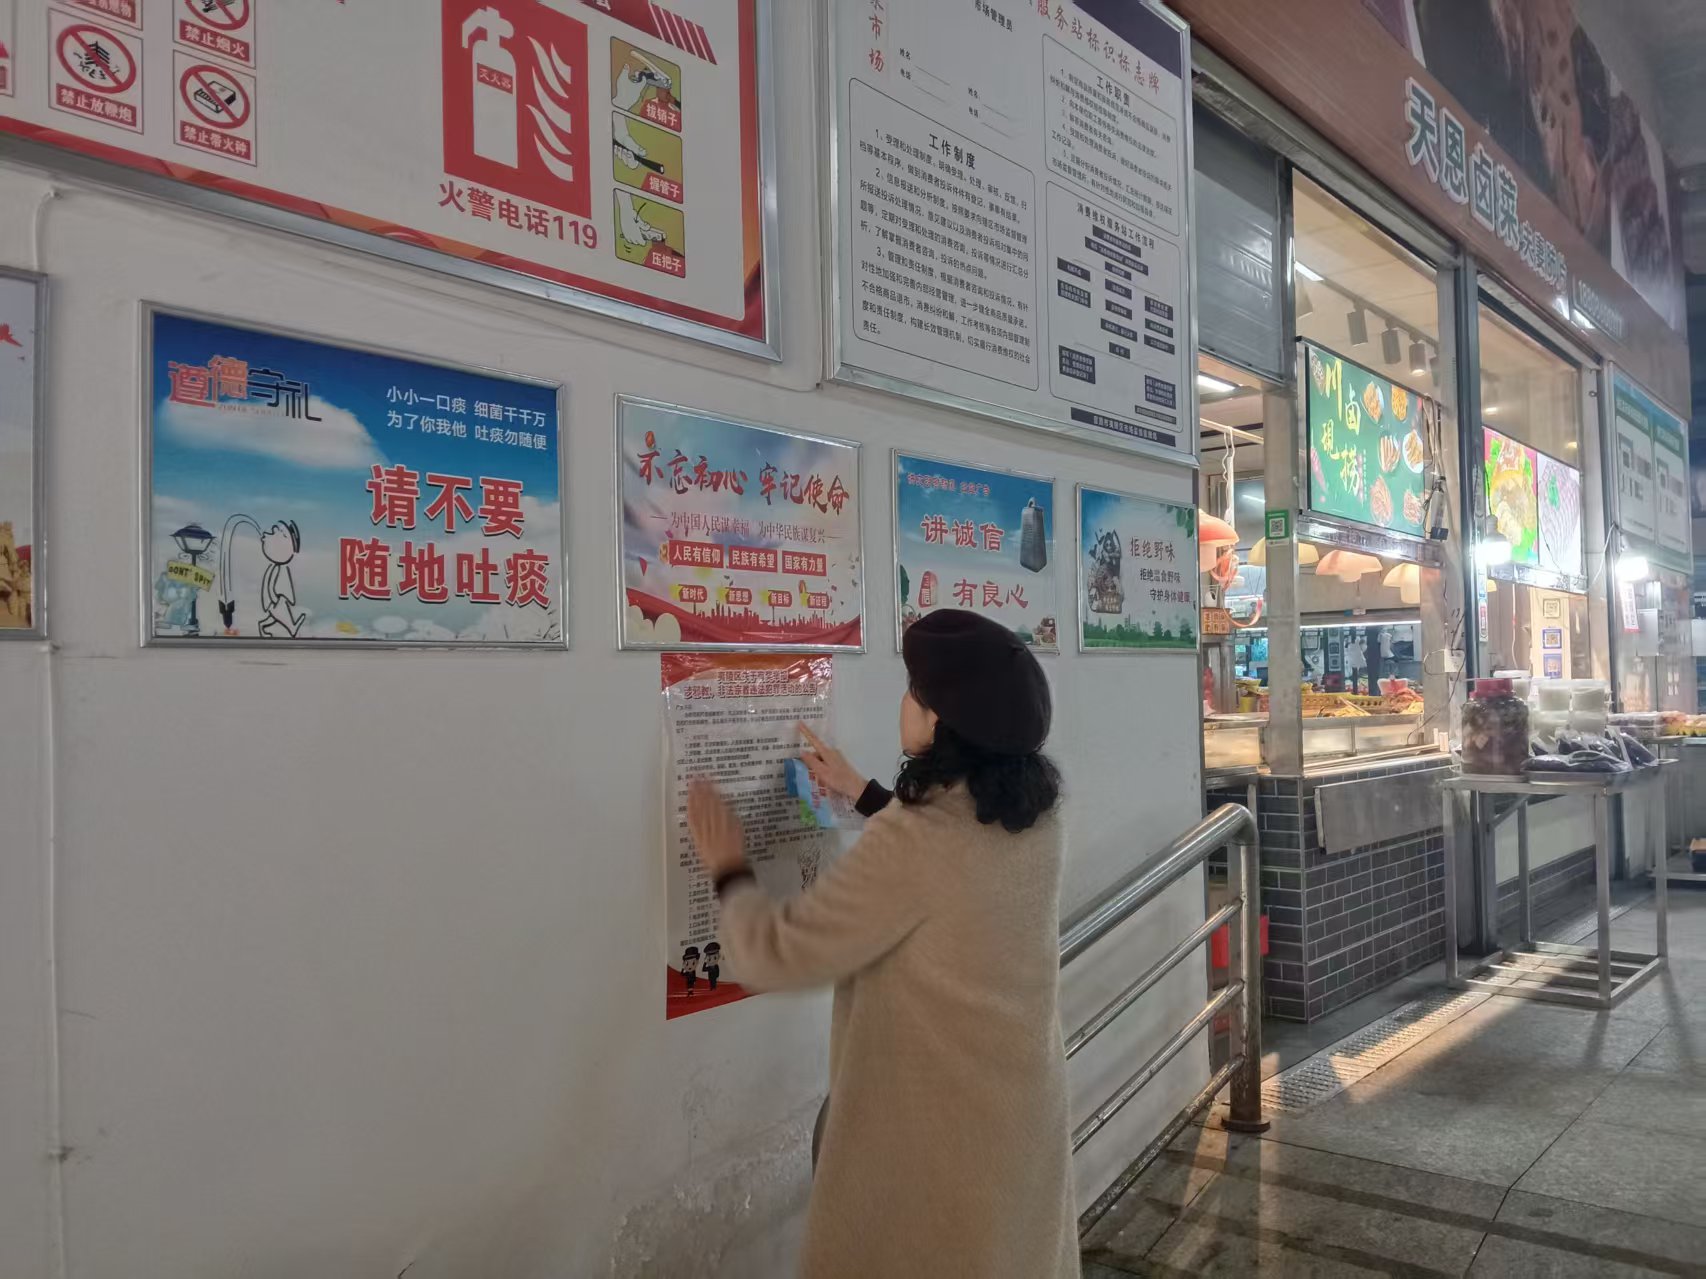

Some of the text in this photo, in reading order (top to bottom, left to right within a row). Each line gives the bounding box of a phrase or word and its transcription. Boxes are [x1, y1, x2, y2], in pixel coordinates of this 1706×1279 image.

[184, 24, 246, 58] 禁止烟火
[478, 66, 513, 91] 灭火器
[1096, 75, 1131, 109] 工作职责
[60, 88, 133, 123] 禁止放鞭炮
[645, 102, 678, 127] 拔销子
[184, 125, 248, 155] 禁止带火种
[928, 133, 977, 170] 工作制度
[1405, 76, 1520, 251] 天恩卤菜
[438, 180, 598, 250] 火警电话119
[651, 250, 683, 273] 压把子
[167, 354, 323, 423] 遵德守礼
[386, 385, 547, 427] 小小一口痰 细菌千千万
[386, 410, 548, 451] 为了你我他 吐痰勿随便
[637, 446, 850, 516] 不忘初心 牢记使命
[366, 462, 526, 539] 请不要
[671, 511, 826, 545] 为中国人民谋幸福 为中华民族谋复兴
[920, 513, 1005, 552] 讲诚信
[673, 544, 825, 573] 人民有信仰 民族有希望 国家有力量
[1130, 537, 1176, 562] 拒绝野味
[338, 537, 553, 611] 随地吐痰
[681, 588, 704, 601] 新时代
[728, 590, 750, 603] 新思想
[770, 593, 791, 605] 新目标
[952, 578, 1029, 609] 有良心
[1149, 588, 1191, 603] 守护身体健康
